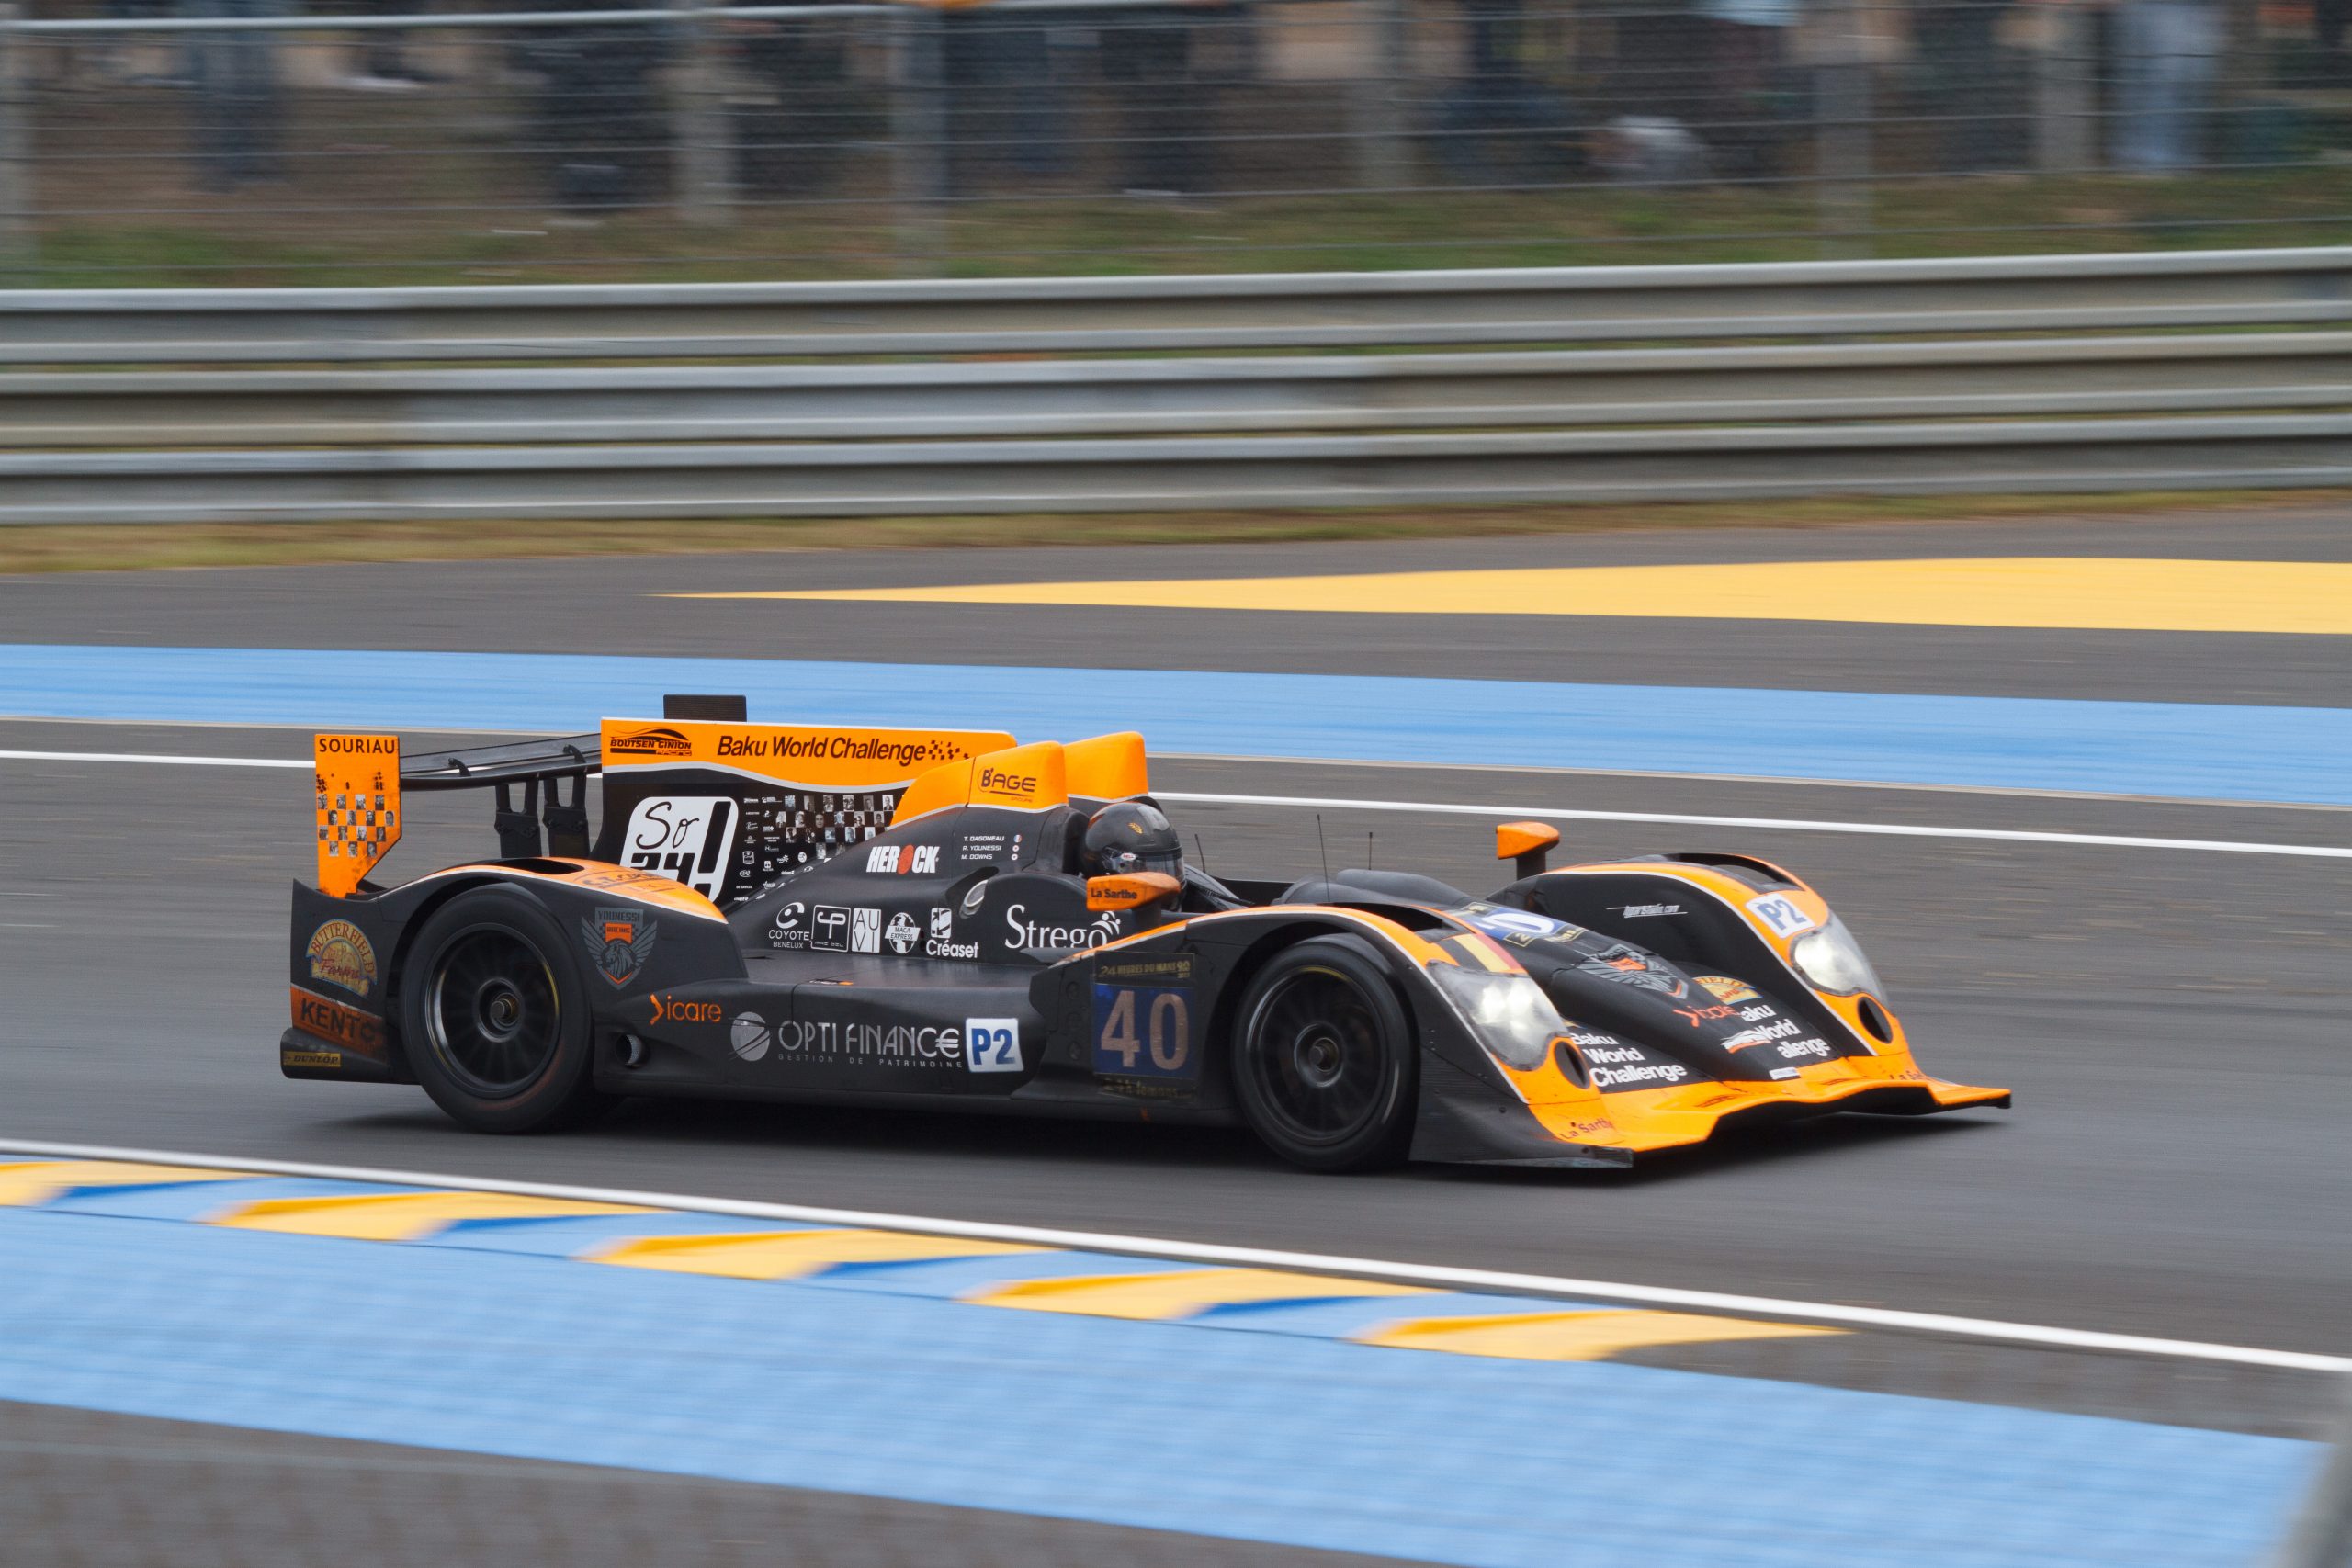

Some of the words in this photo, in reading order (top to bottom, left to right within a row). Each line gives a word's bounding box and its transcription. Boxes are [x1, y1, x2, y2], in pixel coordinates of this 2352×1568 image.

[319, 738, 395, 754] SOURIAU
[610, 739, 655, 749] BOUTSEN
[658, 739, 692, 750] GINION
[717, 735, 768, 757] Baku
[772, 736, 829, 759] World
[830, 737, 927, 767] Challenge
[636, 801, 700, 849] So
[1091, 887, 1102, 898] La
[1104, 888, 1138, 899] Sarthe
[598, 910, 640, 922] YOUNESSI
[1756, 898, 1807, 931] P2
[1004, 904, 1108, 948] Strego
[768, 929, 810, 941] COYOTE
[890, 932, 914, 941] EXPRESS
[311, 921, 376, 974] BUTTERFIELD
[773, 941, 804, 949] BENELUX
[925, 938, 979, 959] Créaset
[666, 994, 722, 1022] icare
[778, 1019, 838, 1053] OPTI
[1100, 990, 1189, 1070] 40
[1569, 1032, 1620, 1045] Baku
[971, 1028, 1016, 1066] P2
[293, 1054, 339, 1065] DUNLOP
[778, 1053, 833, 1064] GESTION
[849, 1057, 864, 1066] DE
[879, 1059, 963, 1068] PATRIMOINE
[1582, 1048, 1646, 1064] World
[1589, 1064, 1688, 1088] Challenge
[1559, 1129, 1580, 1140] La
